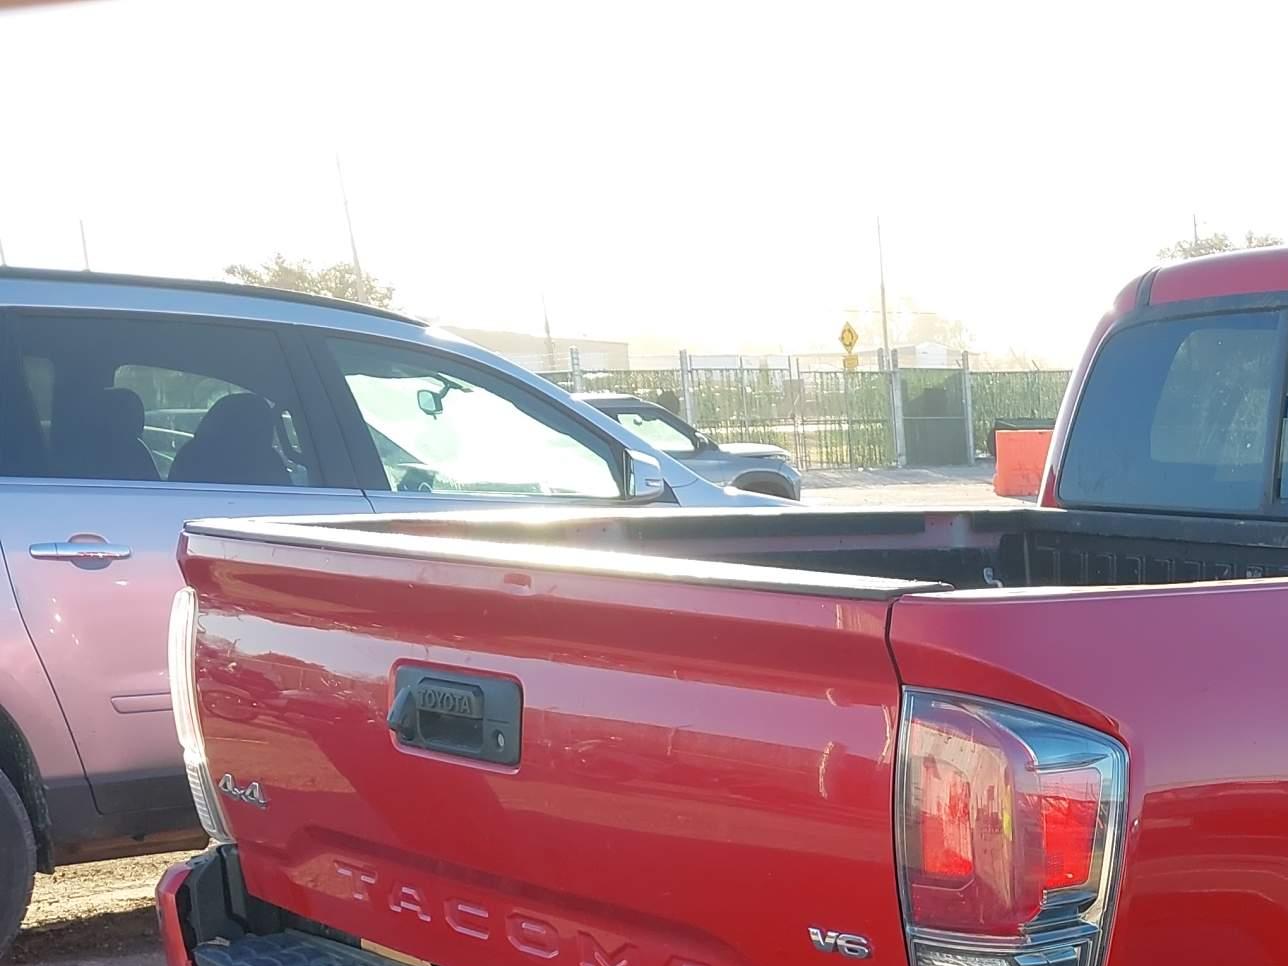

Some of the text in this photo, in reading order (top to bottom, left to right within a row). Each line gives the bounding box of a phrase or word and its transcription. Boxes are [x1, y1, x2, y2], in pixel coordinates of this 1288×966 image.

[418, 689, 471, 714] TOYOTA
[218, 772, 268, 808] 4x4
[807, 927, 869, 958] V6
